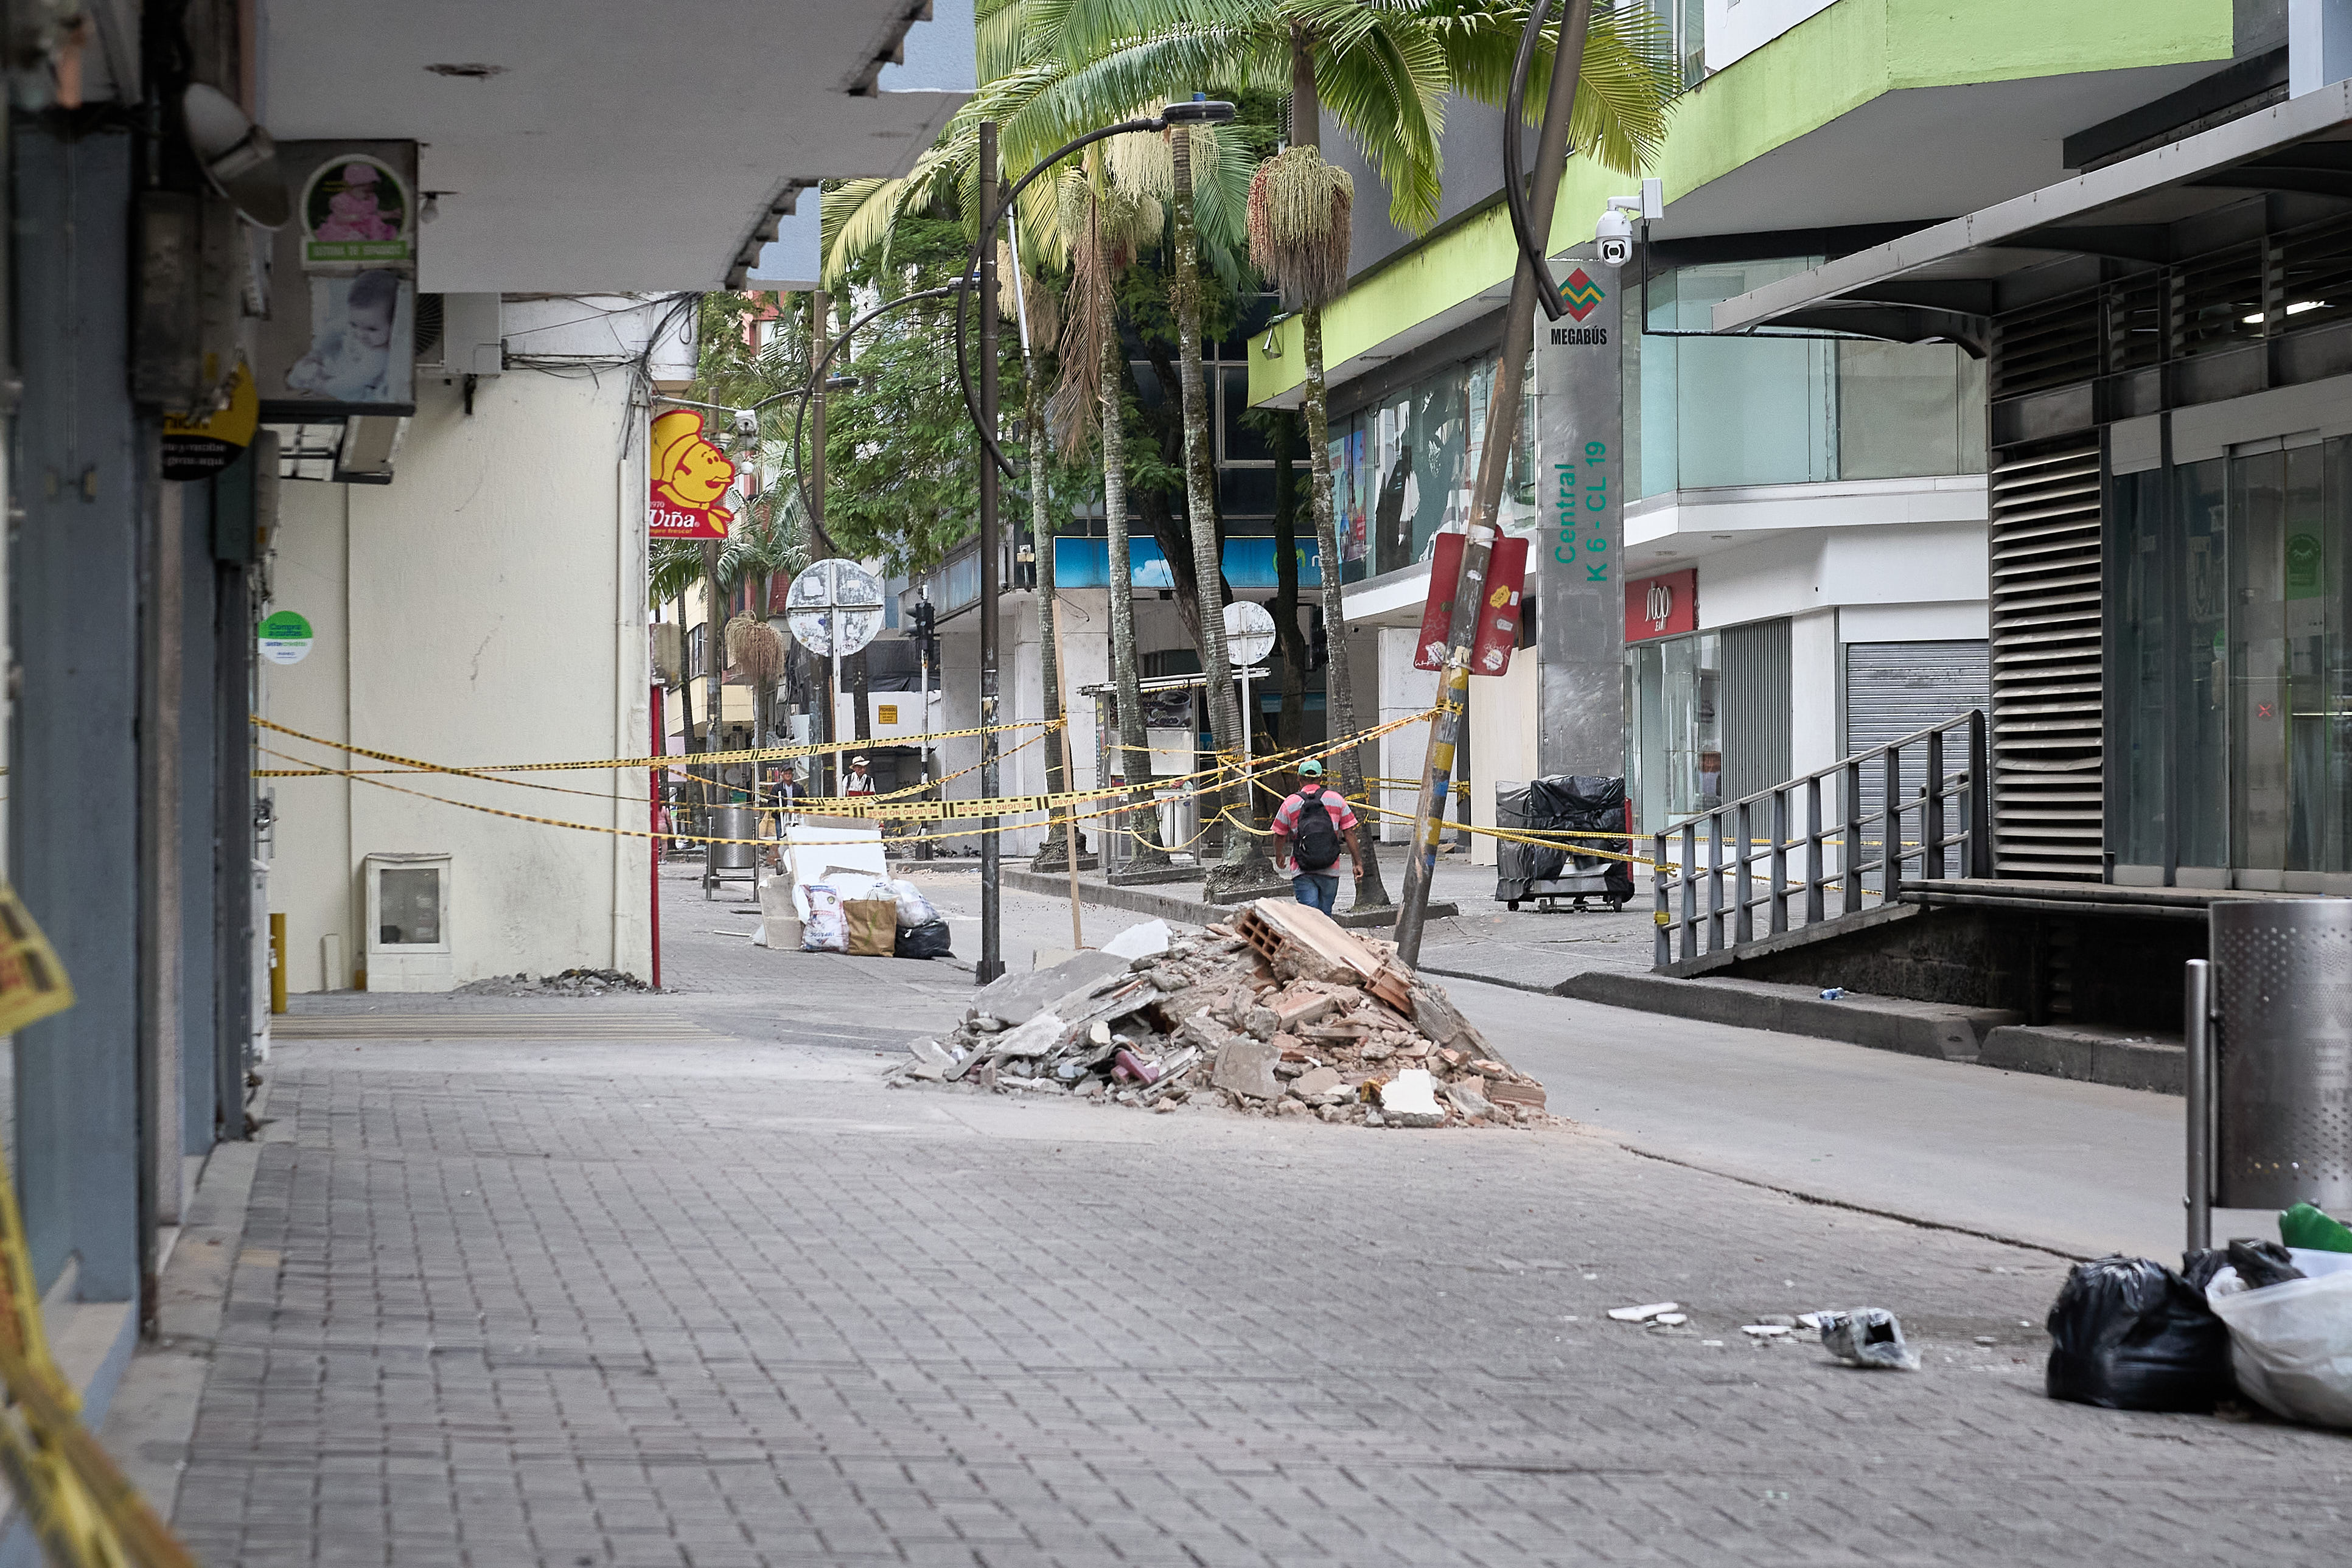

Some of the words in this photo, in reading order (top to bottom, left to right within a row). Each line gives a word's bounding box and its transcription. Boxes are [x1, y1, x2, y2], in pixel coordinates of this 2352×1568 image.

[1551, 325, 1607, 345] MEGABÚS
[1585, 441, 1607, 468] 19
[1586, 476, 1607, 512] CL
[1554, 464, 1576, 564] Central
[1586, 538, 1607, 552] 6
[1586, 563, 1608, 582] K
[903, 807, 938, 815] PELIGRO
